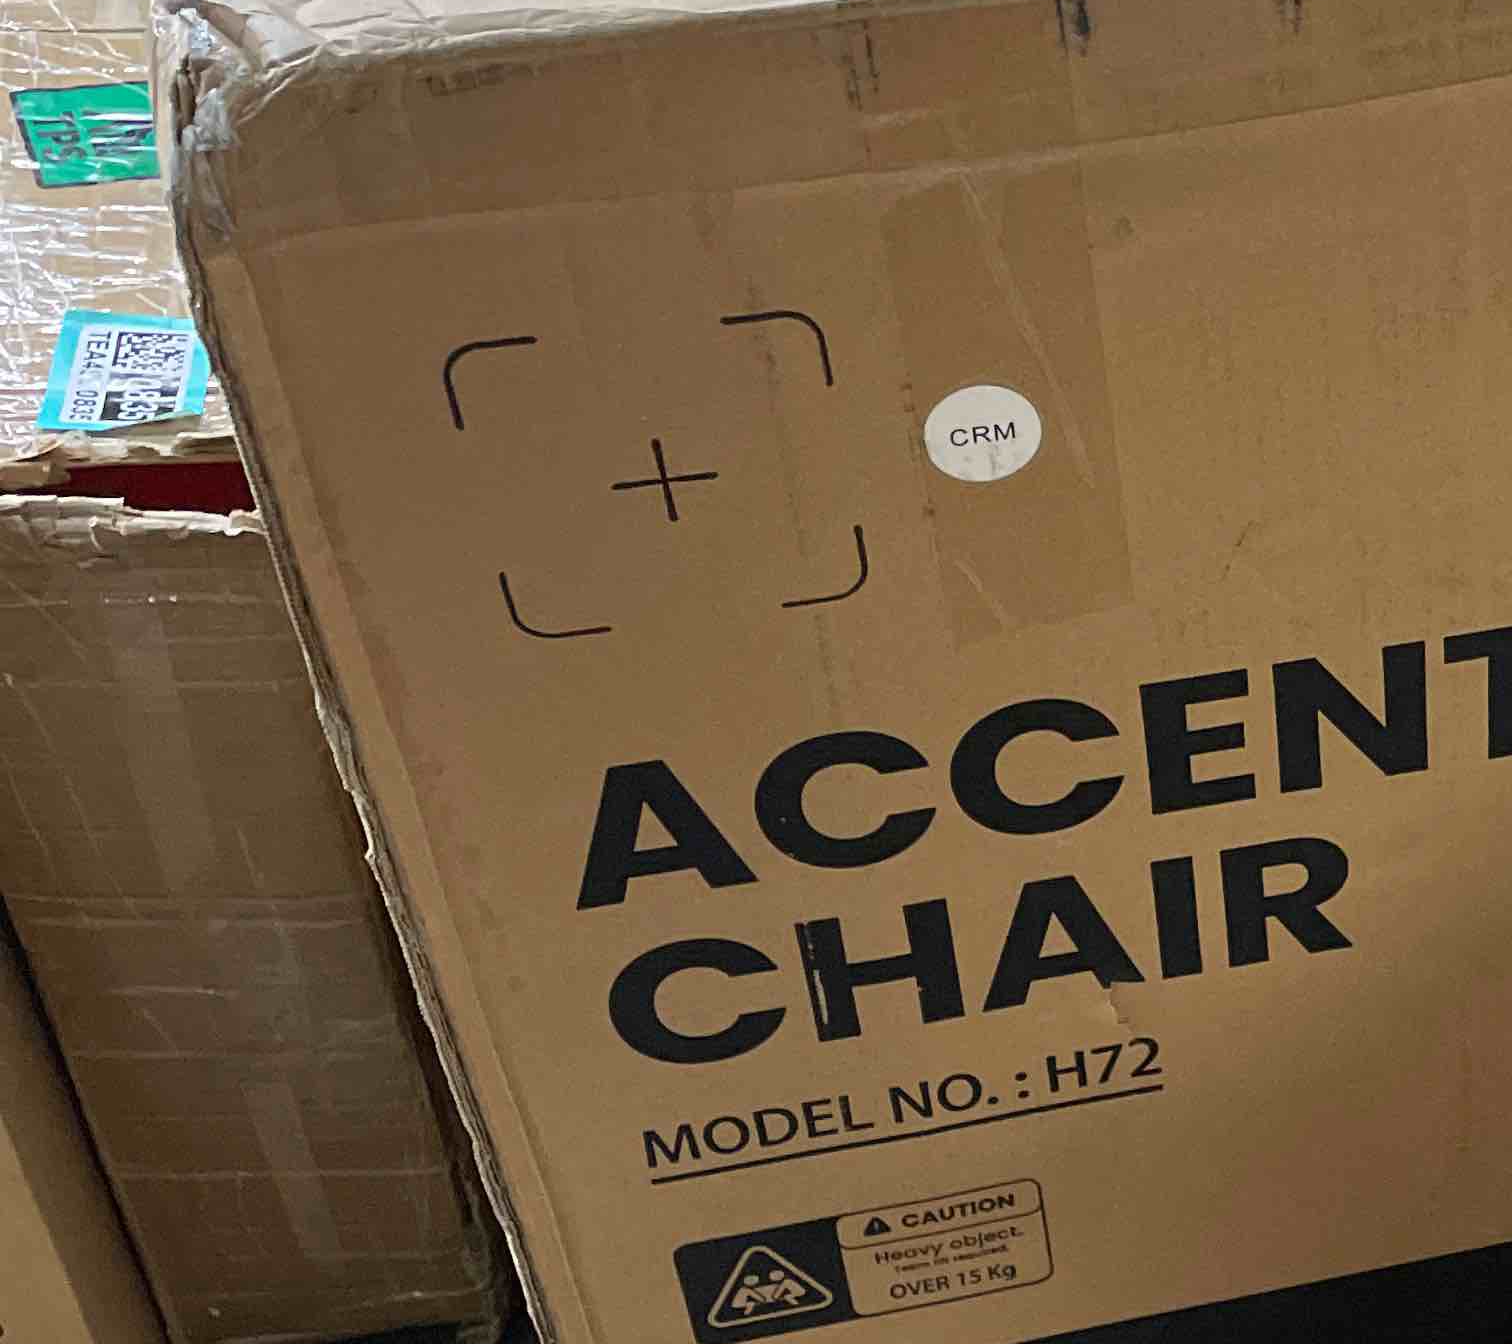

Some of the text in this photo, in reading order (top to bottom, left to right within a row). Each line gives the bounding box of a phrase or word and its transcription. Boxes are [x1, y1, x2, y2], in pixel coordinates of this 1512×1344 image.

[948, 421, 1018, 449] CRM
[607, 836, 1354, 1065] CHAIR
[642, 1094, 875, 1169] MODEL
[1046, 1037, 1163, 1094] H72
[901, 1192, 1016, 1228] CAUTION
[874, 1242, 945, 1265] Heavy
[889, 1263, 1018, 1299] OVER 15 Kg
